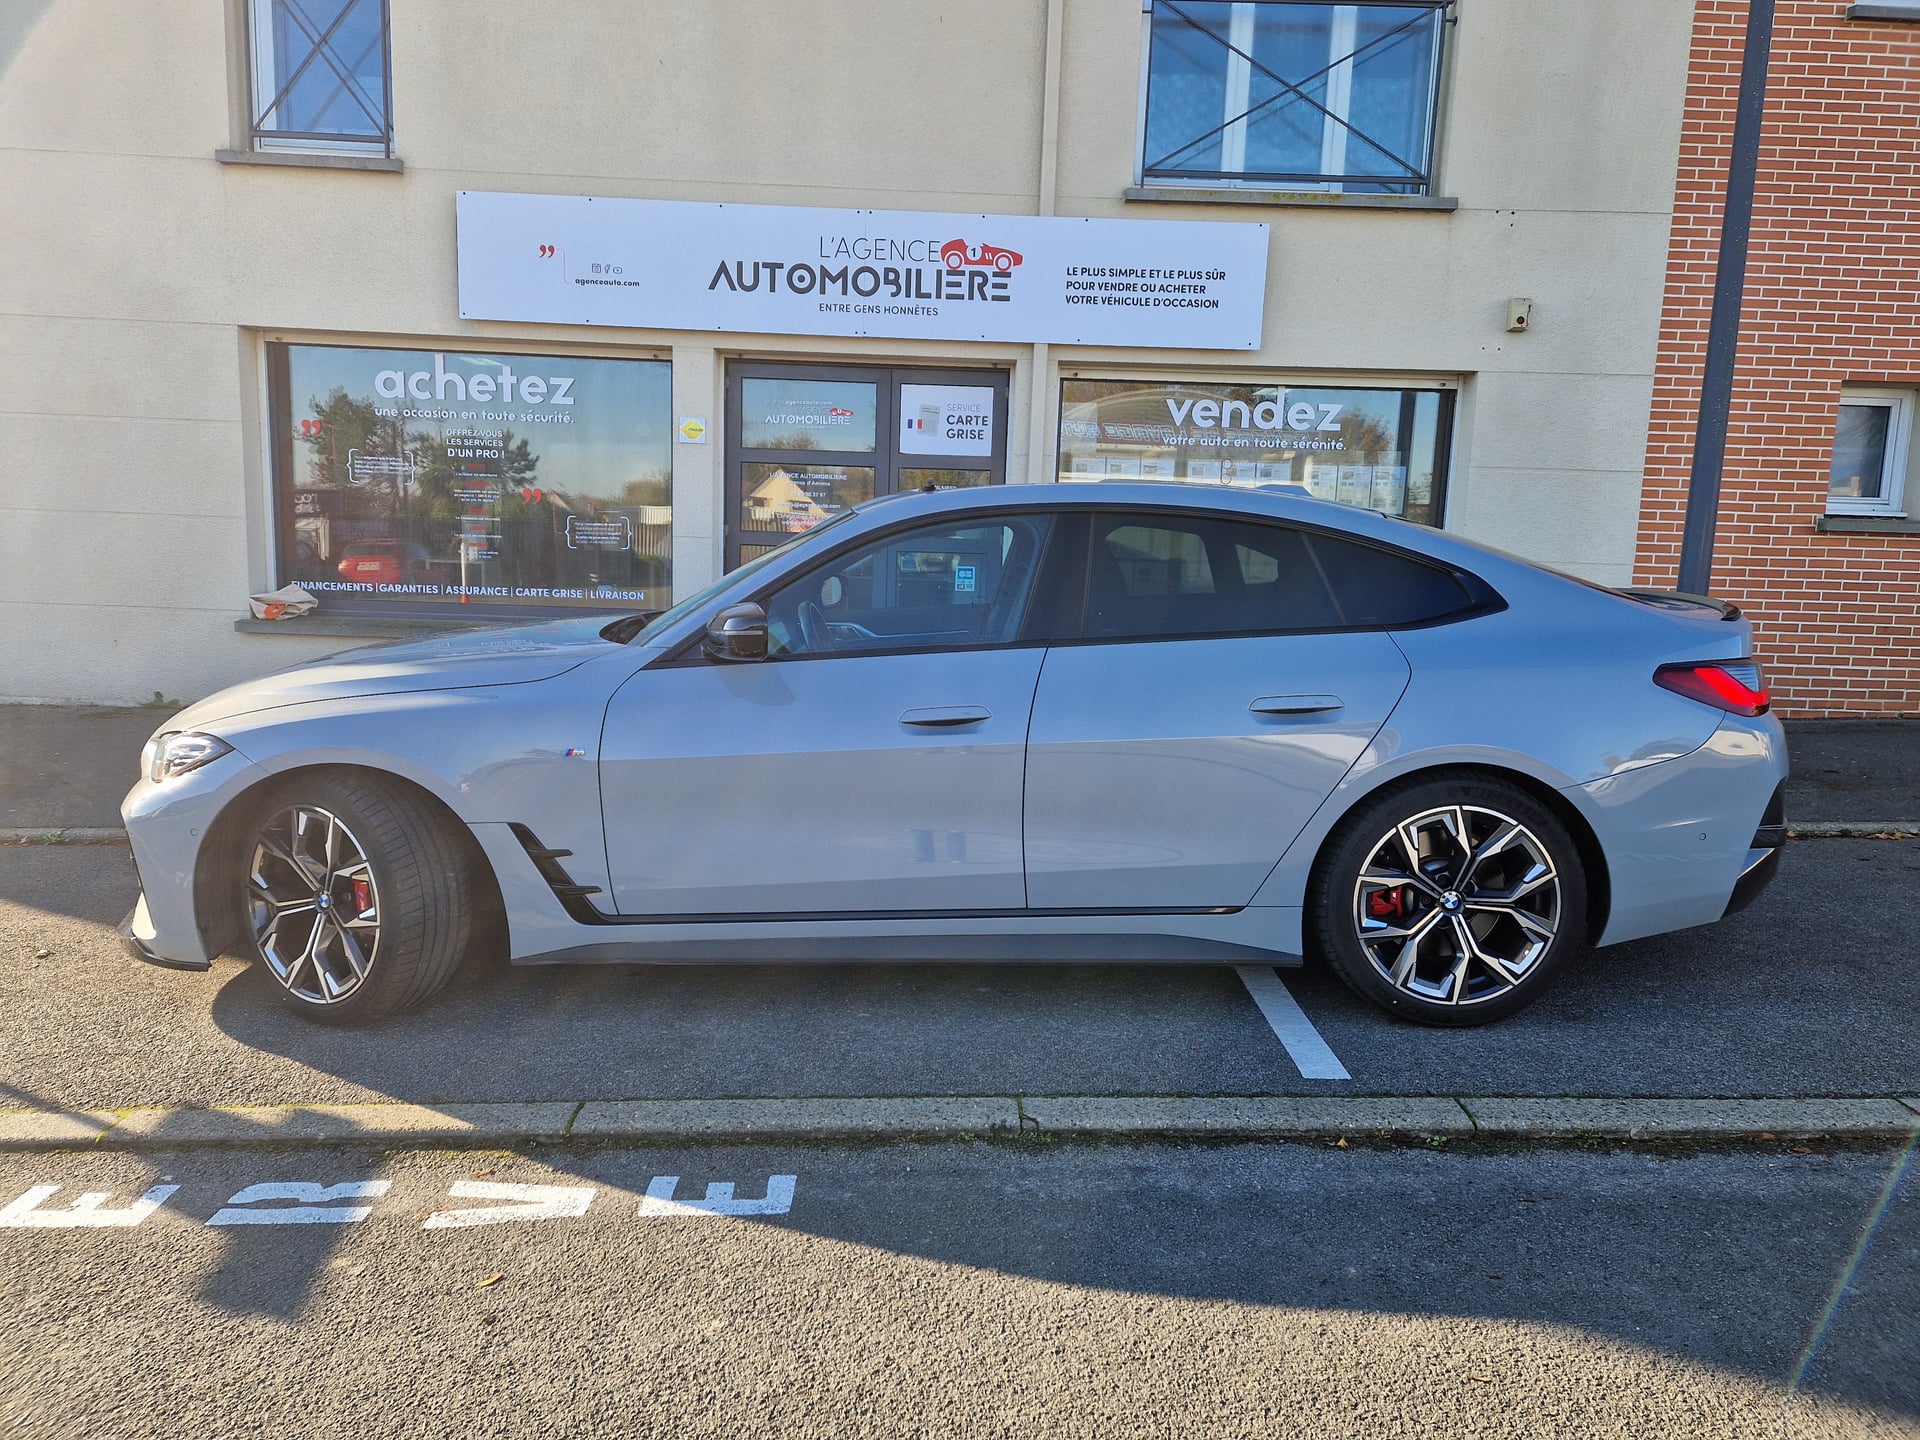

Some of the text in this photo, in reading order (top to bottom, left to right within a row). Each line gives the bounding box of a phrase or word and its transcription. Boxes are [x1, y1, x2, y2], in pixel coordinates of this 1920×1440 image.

[820, 236, 941, 262] L'AGENCE
[1066, 266, 1226, 281] LE PLUS SIMPLE ET LE PLUS SÛR
[575, 277, 640, 288] agenceauto.com
[1066, 281, 1207, 294] POUR VENDRE OU ACHETER
[1065, 293, 1219, 308] VOTRE VÉHICULE D'OCCASION
[819, 303, 939, 316] ENTRE GENS HONNÊTES
[374, 353, 576, 405] achetez
[946, 403, 981, 413] SERVICE
[1166, 388, 1344, 432] vendez
[374, 407, 576, 424] une occasion en toute sécurité.
[946, 414, 989, 426] CARTE
[446, 428, 503, 438] OFFREZ-VOUS
[946, 428, 984, 440] GRISE
[463, 439, 504, 447] SERVICES
[1162, 436, 1347, 451] votre auto en toute sérénité.
[447, 448, 473, 458] D'UN
[476, 449, 499, 459] PRO
[379, 583, 438, 594] GARANTIES
[446, 585, 508, 596] ASSURANCE
[515, 588, 550, 597] CARTE
[552, 589, 583, 598] GRISE
[590, 590, 645, 600] LIVRAISON
